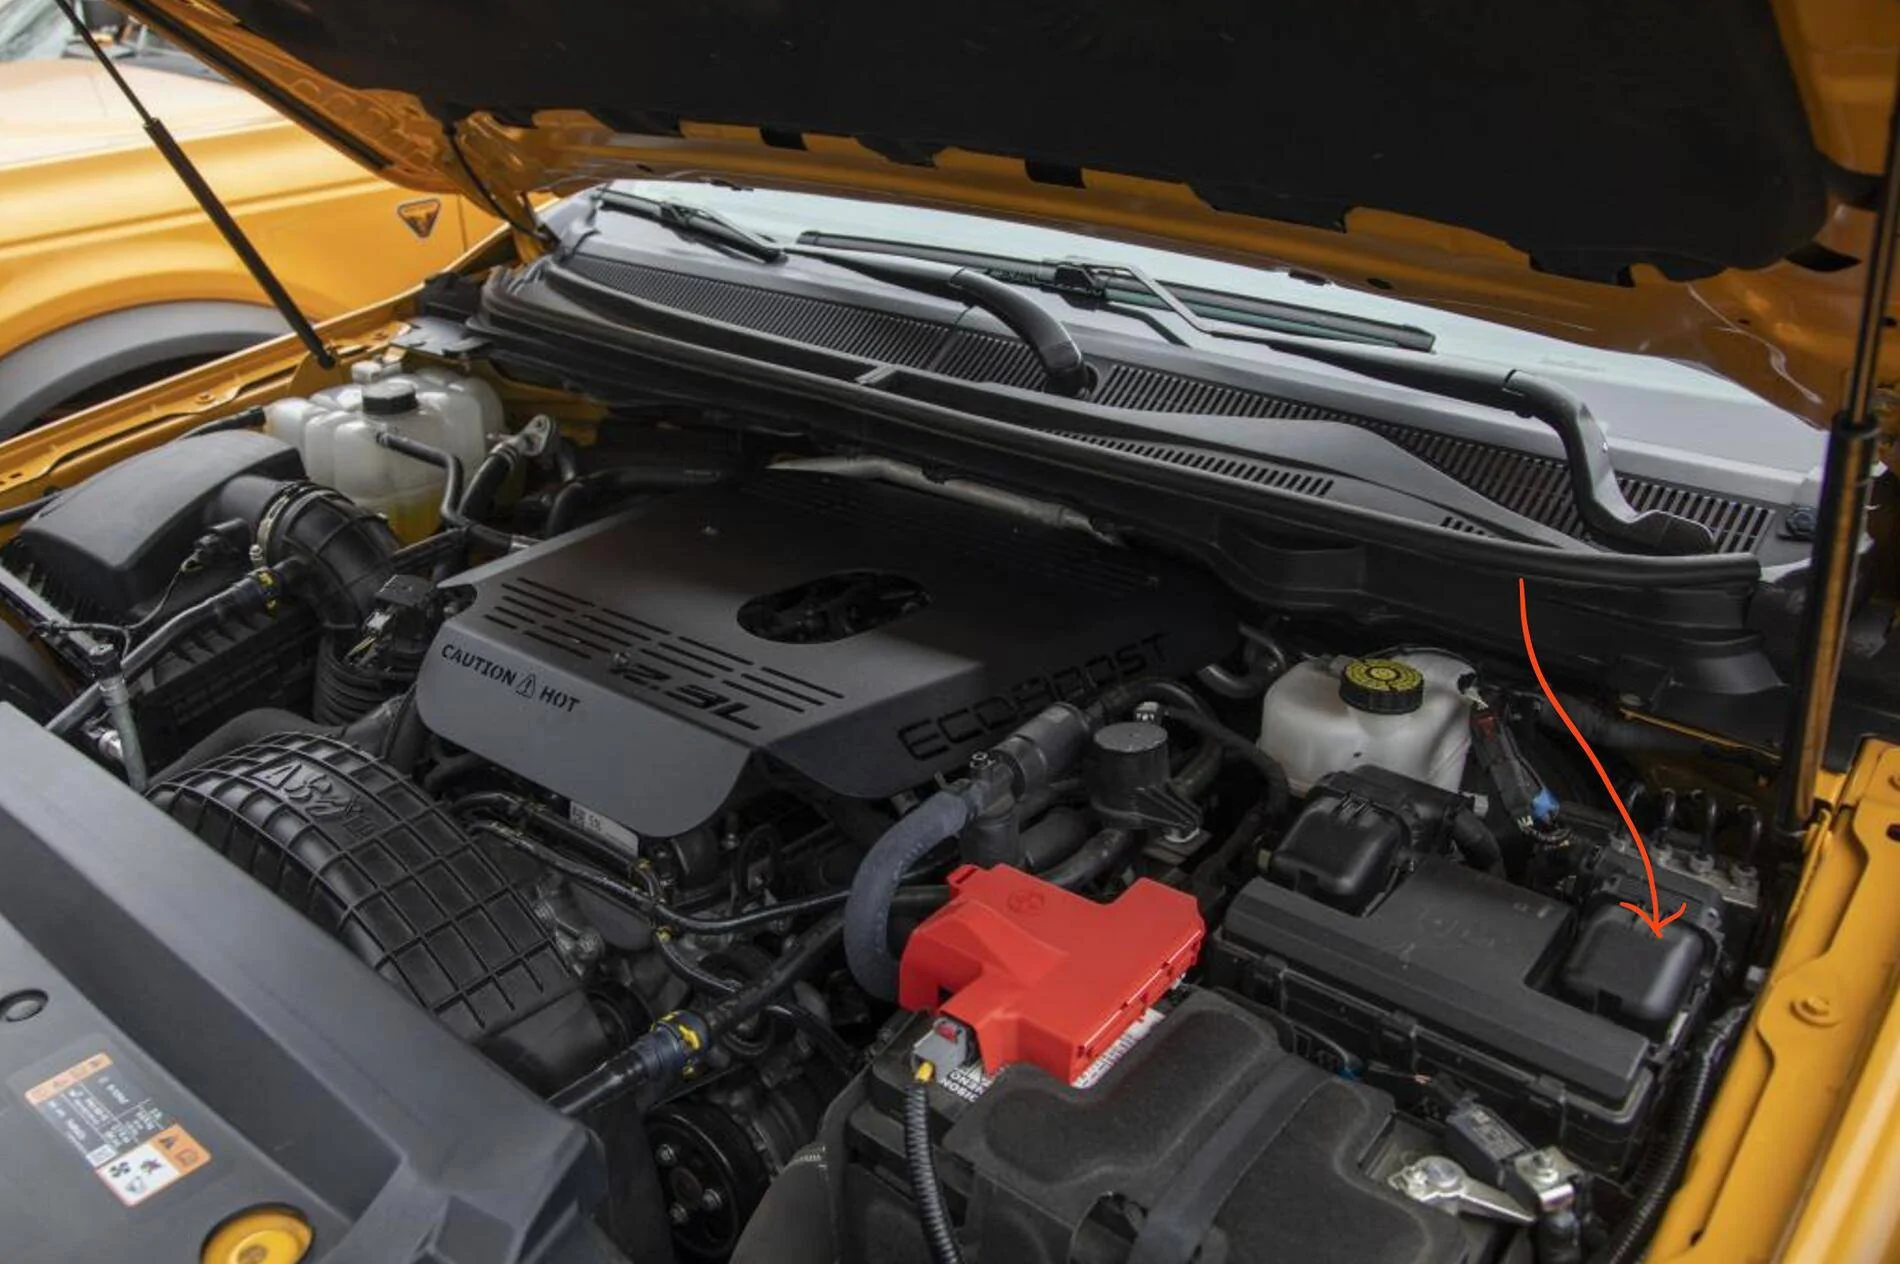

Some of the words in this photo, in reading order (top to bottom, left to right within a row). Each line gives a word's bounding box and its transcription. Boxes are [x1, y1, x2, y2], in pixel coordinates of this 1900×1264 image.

[441, 644, 517, 686] CAUTION
[539, 685, 581, 712] HOT
[898, 632, 1170, 761] ECOBOOST
